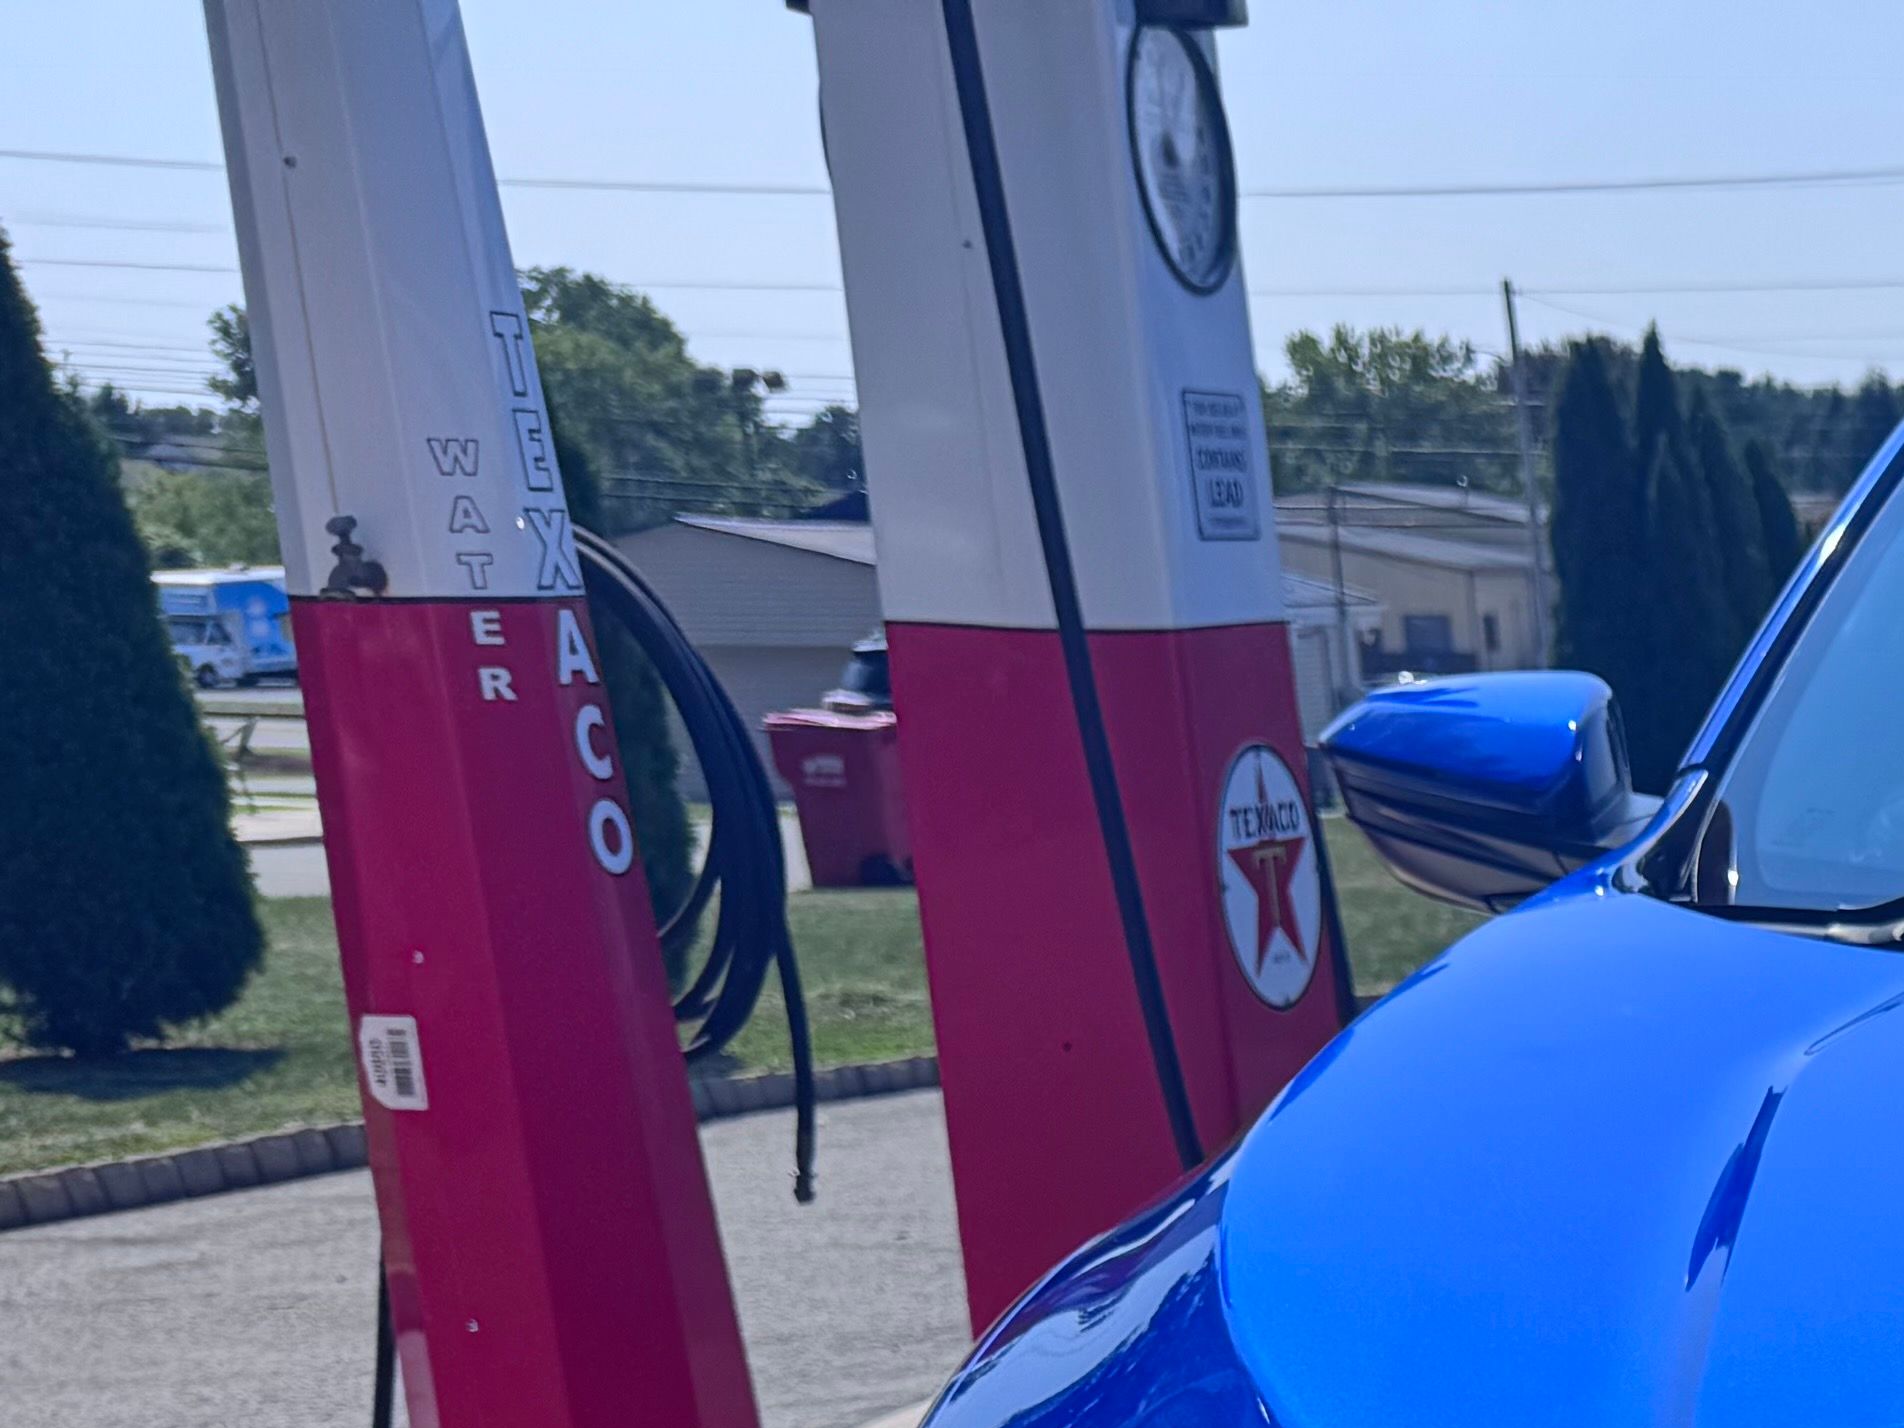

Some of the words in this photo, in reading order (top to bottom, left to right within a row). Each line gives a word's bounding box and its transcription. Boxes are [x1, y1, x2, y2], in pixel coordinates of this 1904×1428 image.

[427, 437, 517, 701] WATER
[1209, 479, 1244, 507] LEAD
[490, 311, 633, 875] TEXACO
[1230, 800, 1299, 840] TEXACO
